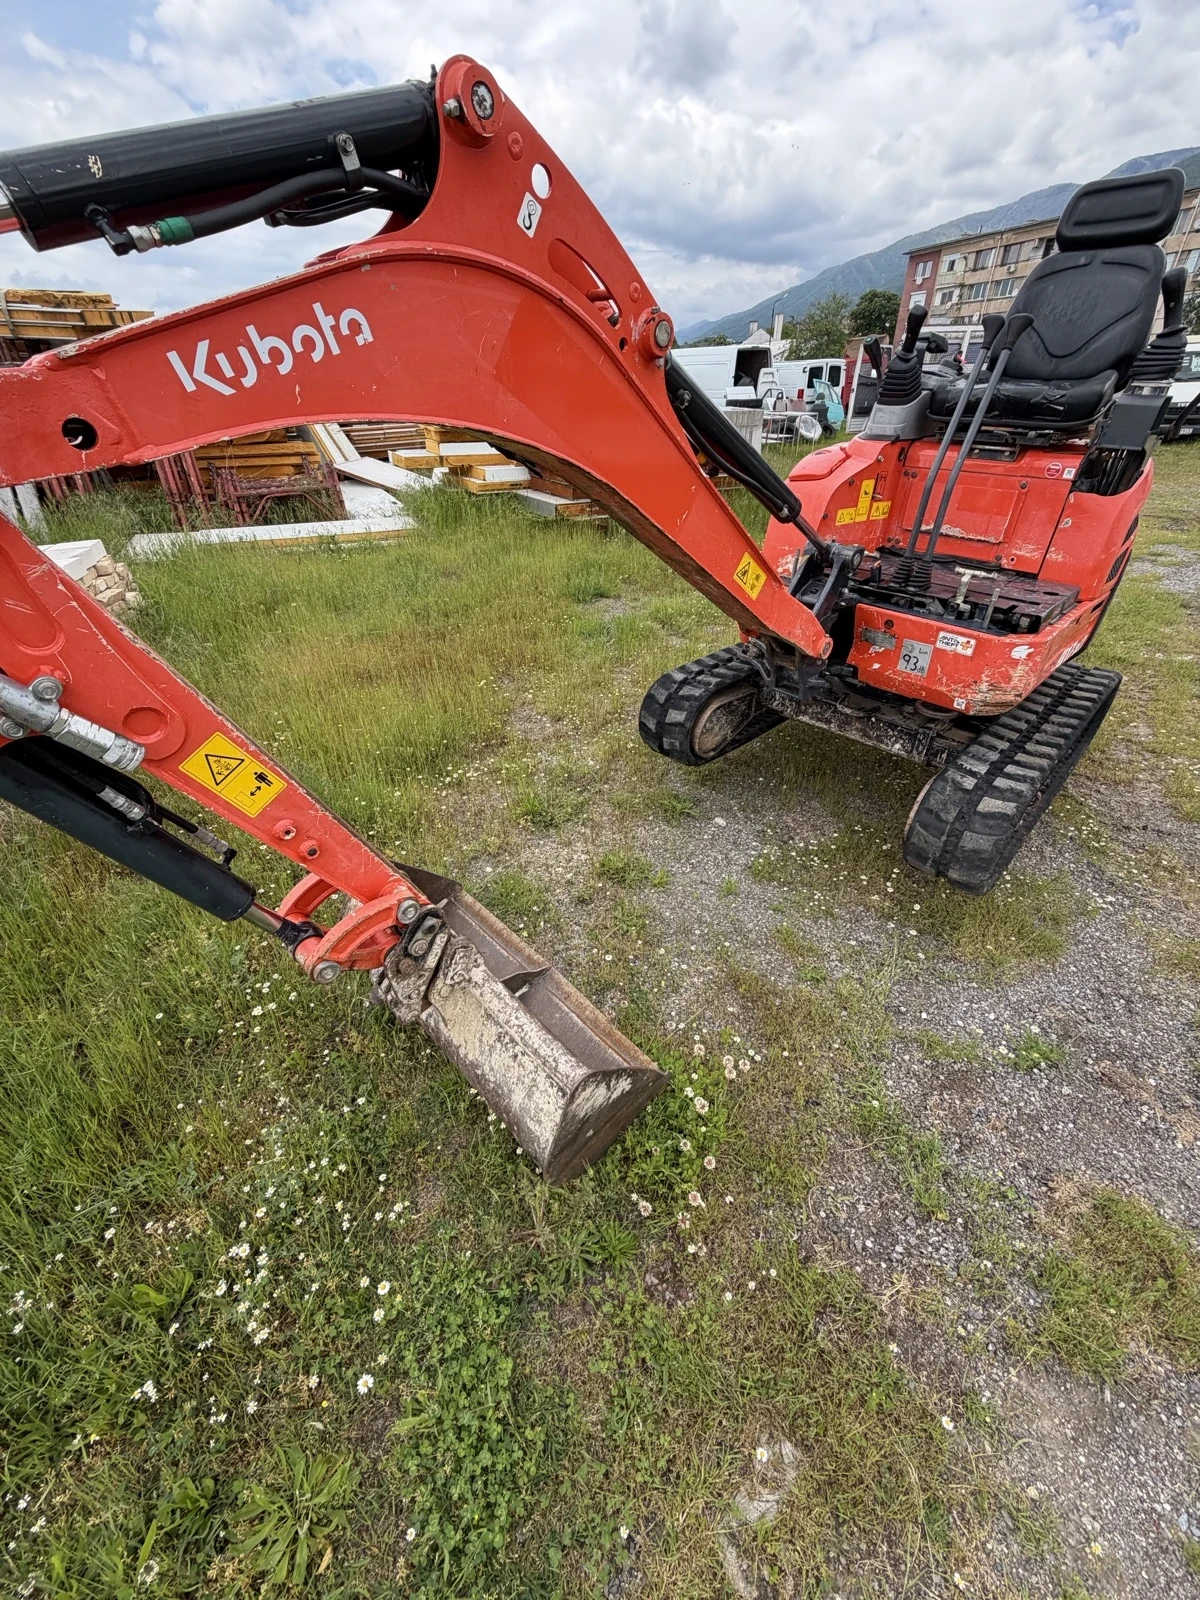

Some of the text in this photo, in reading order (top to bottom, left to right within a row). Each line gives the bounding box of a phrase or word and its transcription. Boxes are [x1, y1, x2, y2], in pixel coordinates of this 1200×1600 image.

[166, 302, 374, 396] Kubota
[939, 640, 958, 648] THEFT
[903, 653, 919, 671] 93
